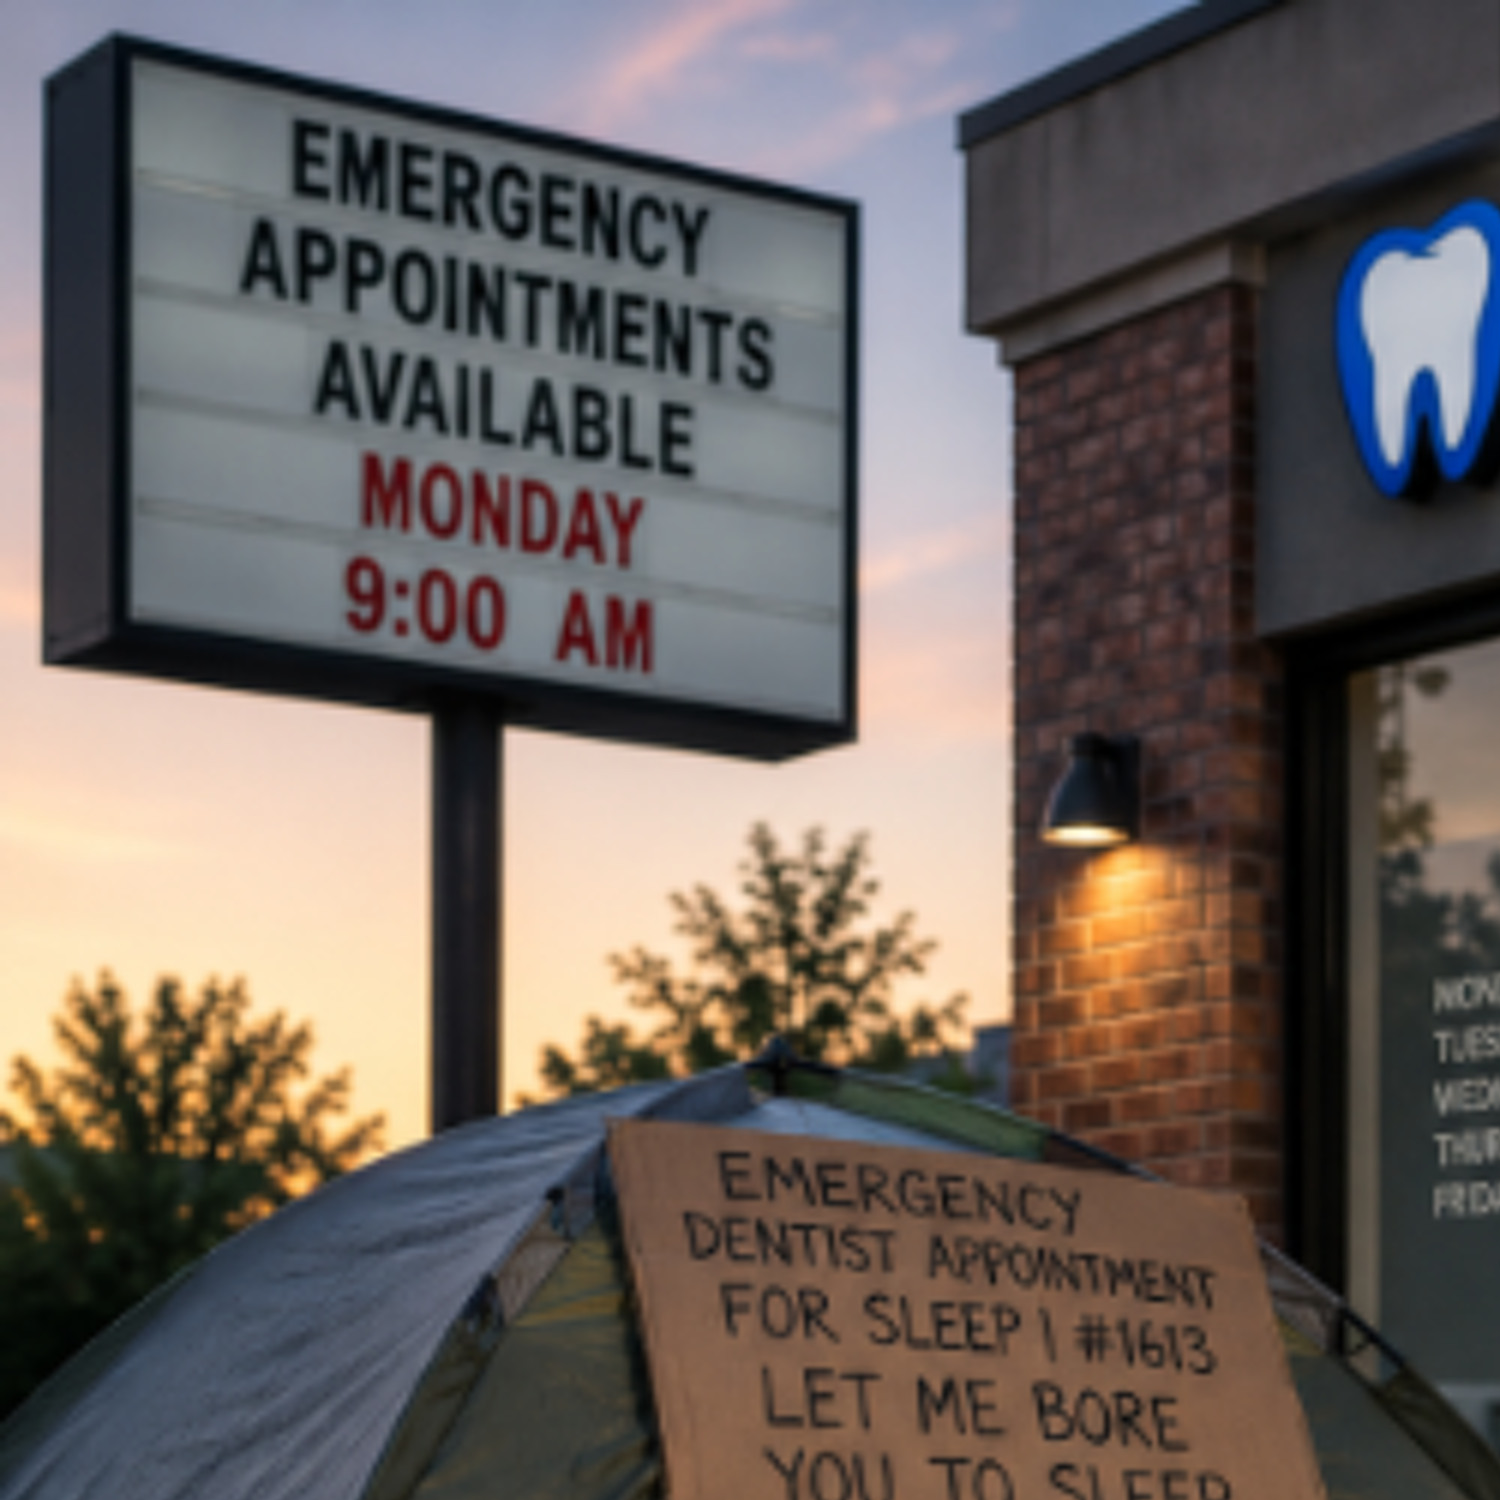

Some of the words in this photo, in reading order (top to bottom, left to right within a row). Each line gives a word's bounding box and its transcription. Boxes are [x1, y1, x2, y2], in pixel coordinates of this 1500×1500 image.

[292, 118, 709, 276] EMERGENCY
[240, 219, 774, 391] APPOINTMENTS
[314, 341, 695, 478] AVAILABLE
[361, 452, 644, 568] MONDAY
[345, 557, 505, 650] 9:00
[555, 591, 654, 674] AM
[718, 1151, 1082, 1234] EMERGENCY
[683, 1212, 896, 1275] DENTIST
[929, 1235, 1218, 1309] APPOINTMENT
[720, 1283, 840, 1343] FOR
[862, 1294, 1022, 1357] SLEEP
[1075, 1315, 1215, 1376] #1613
[762, 1366, 881, 1430] LET
[917, 1376, 1006, 1437] ME
[1033, 1380, 1189, 1452] BORE
